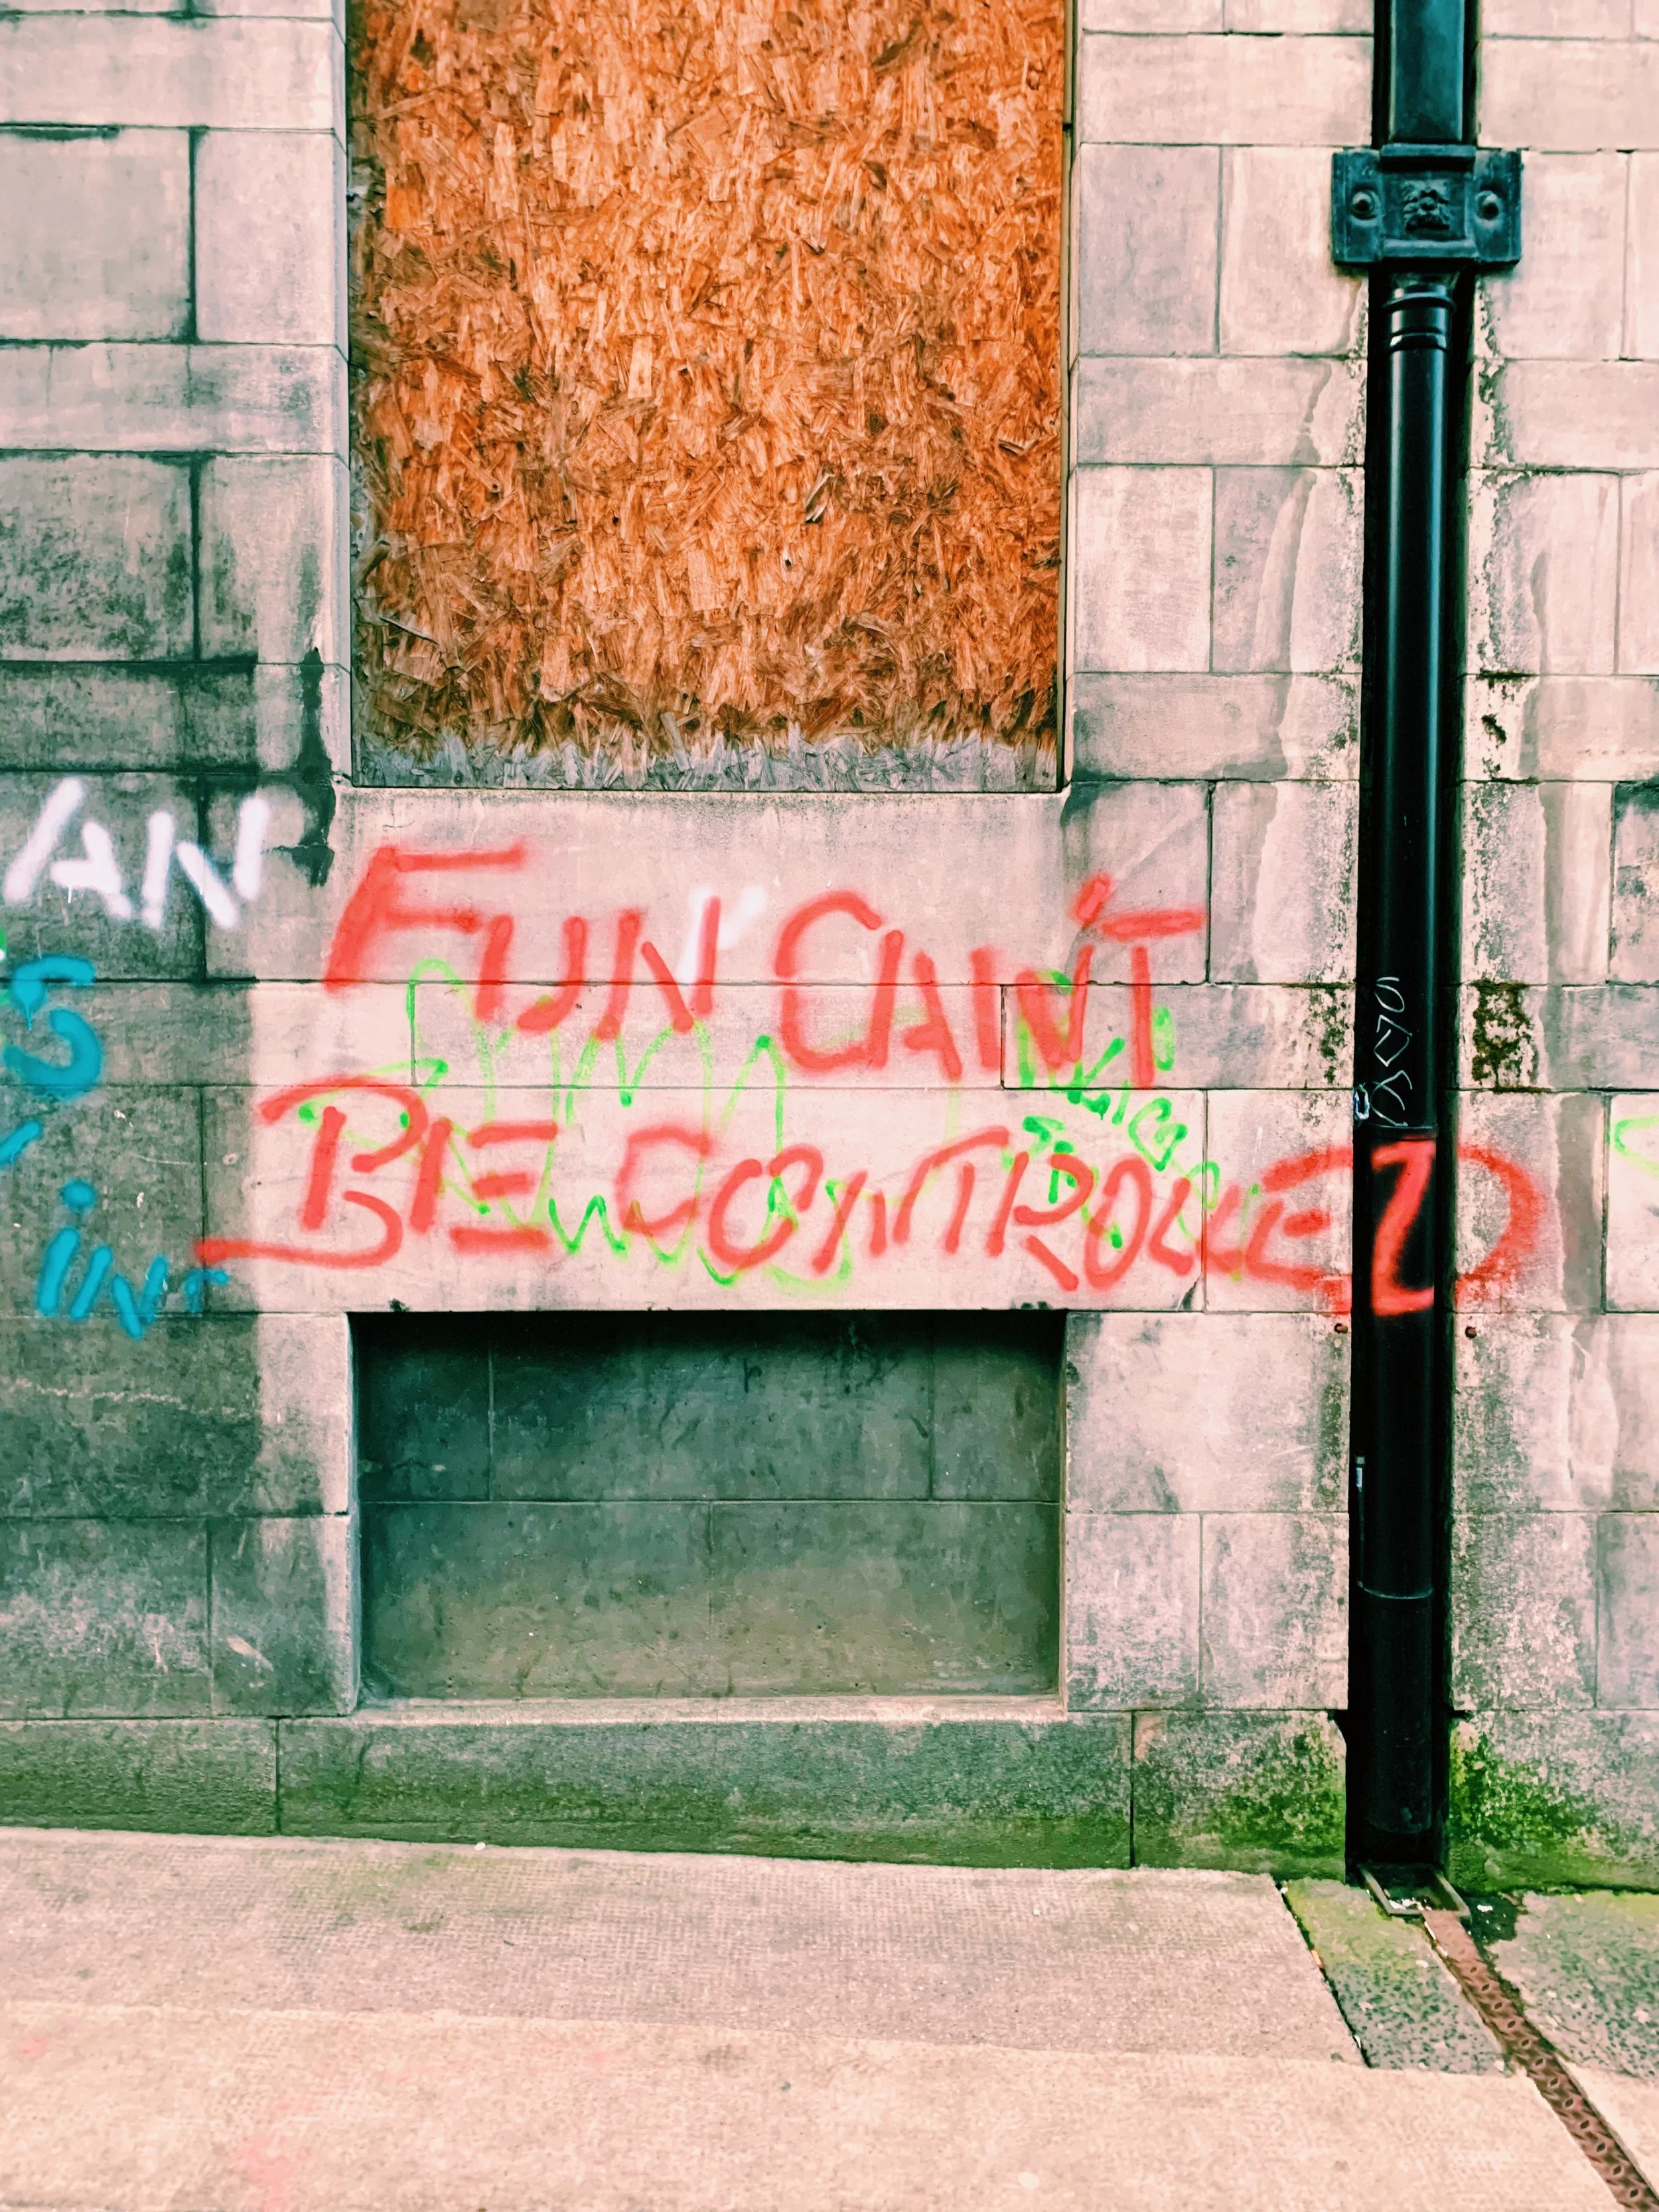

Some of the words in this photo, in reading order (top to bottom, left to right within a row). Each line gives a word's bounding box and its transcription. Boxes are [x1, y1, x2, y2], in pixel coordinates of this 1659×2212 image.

[323, 842, 723, 1041] FUN
[773, 873, 1204, 1090] CAN'T
[196, 1074, 559, 1269] BE
[614, 1123, 1546, 1318] CONTROLLED
